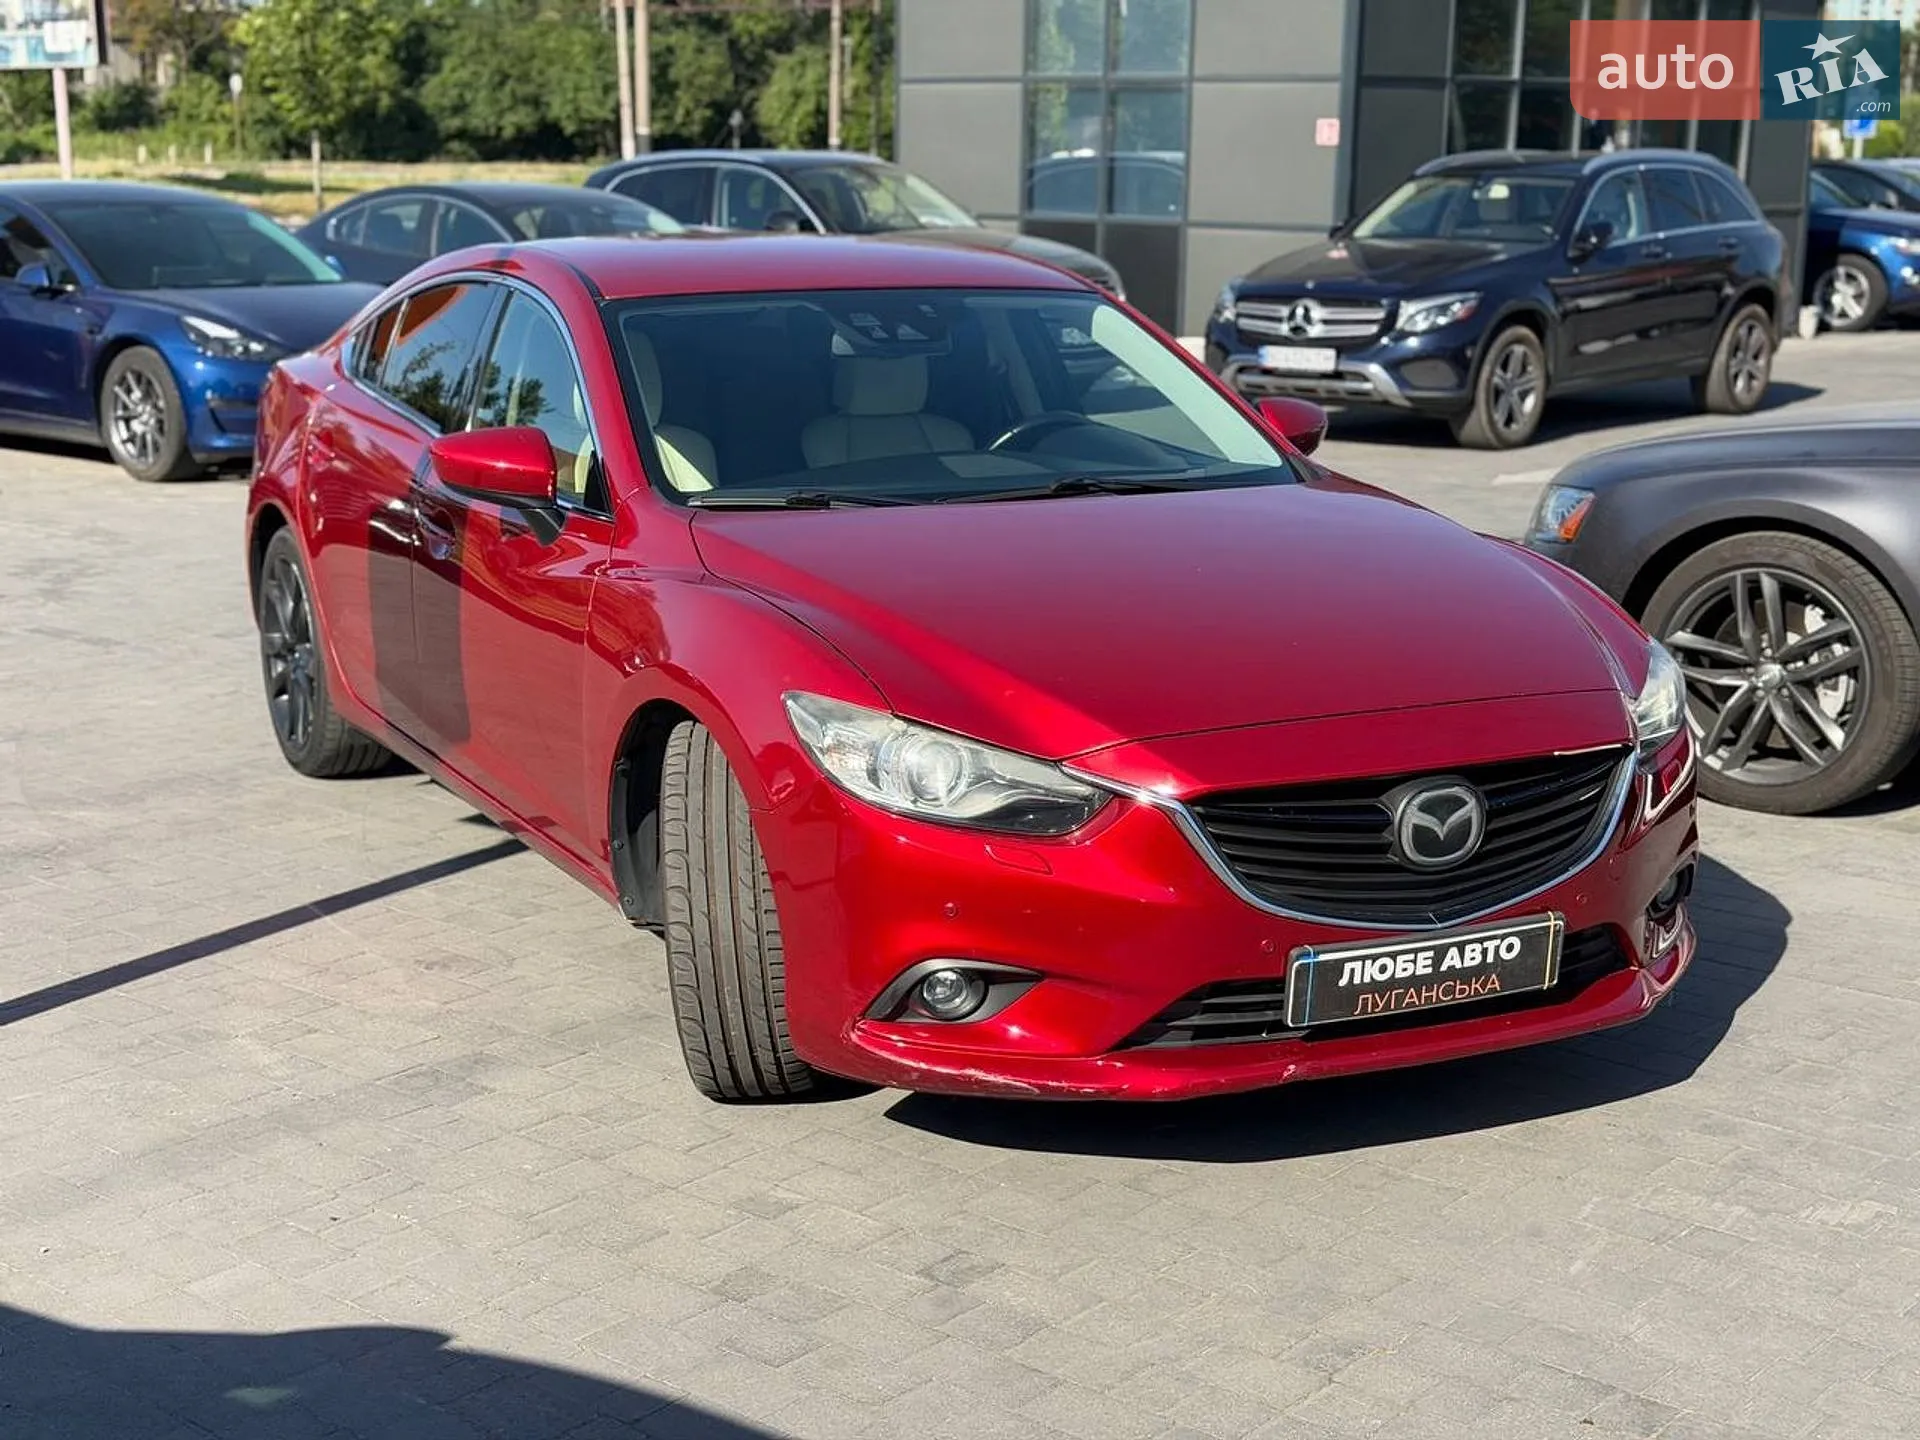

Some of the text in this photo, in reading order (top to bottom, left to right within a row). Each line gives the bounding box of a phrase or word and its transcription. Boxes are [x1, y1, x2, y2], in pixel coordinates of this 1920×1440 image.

[1338, 936, 1521, 987] ЛЮБЕ АВТО
[1354, 974, 1501, 1015] ЛУГАНСЬКА
